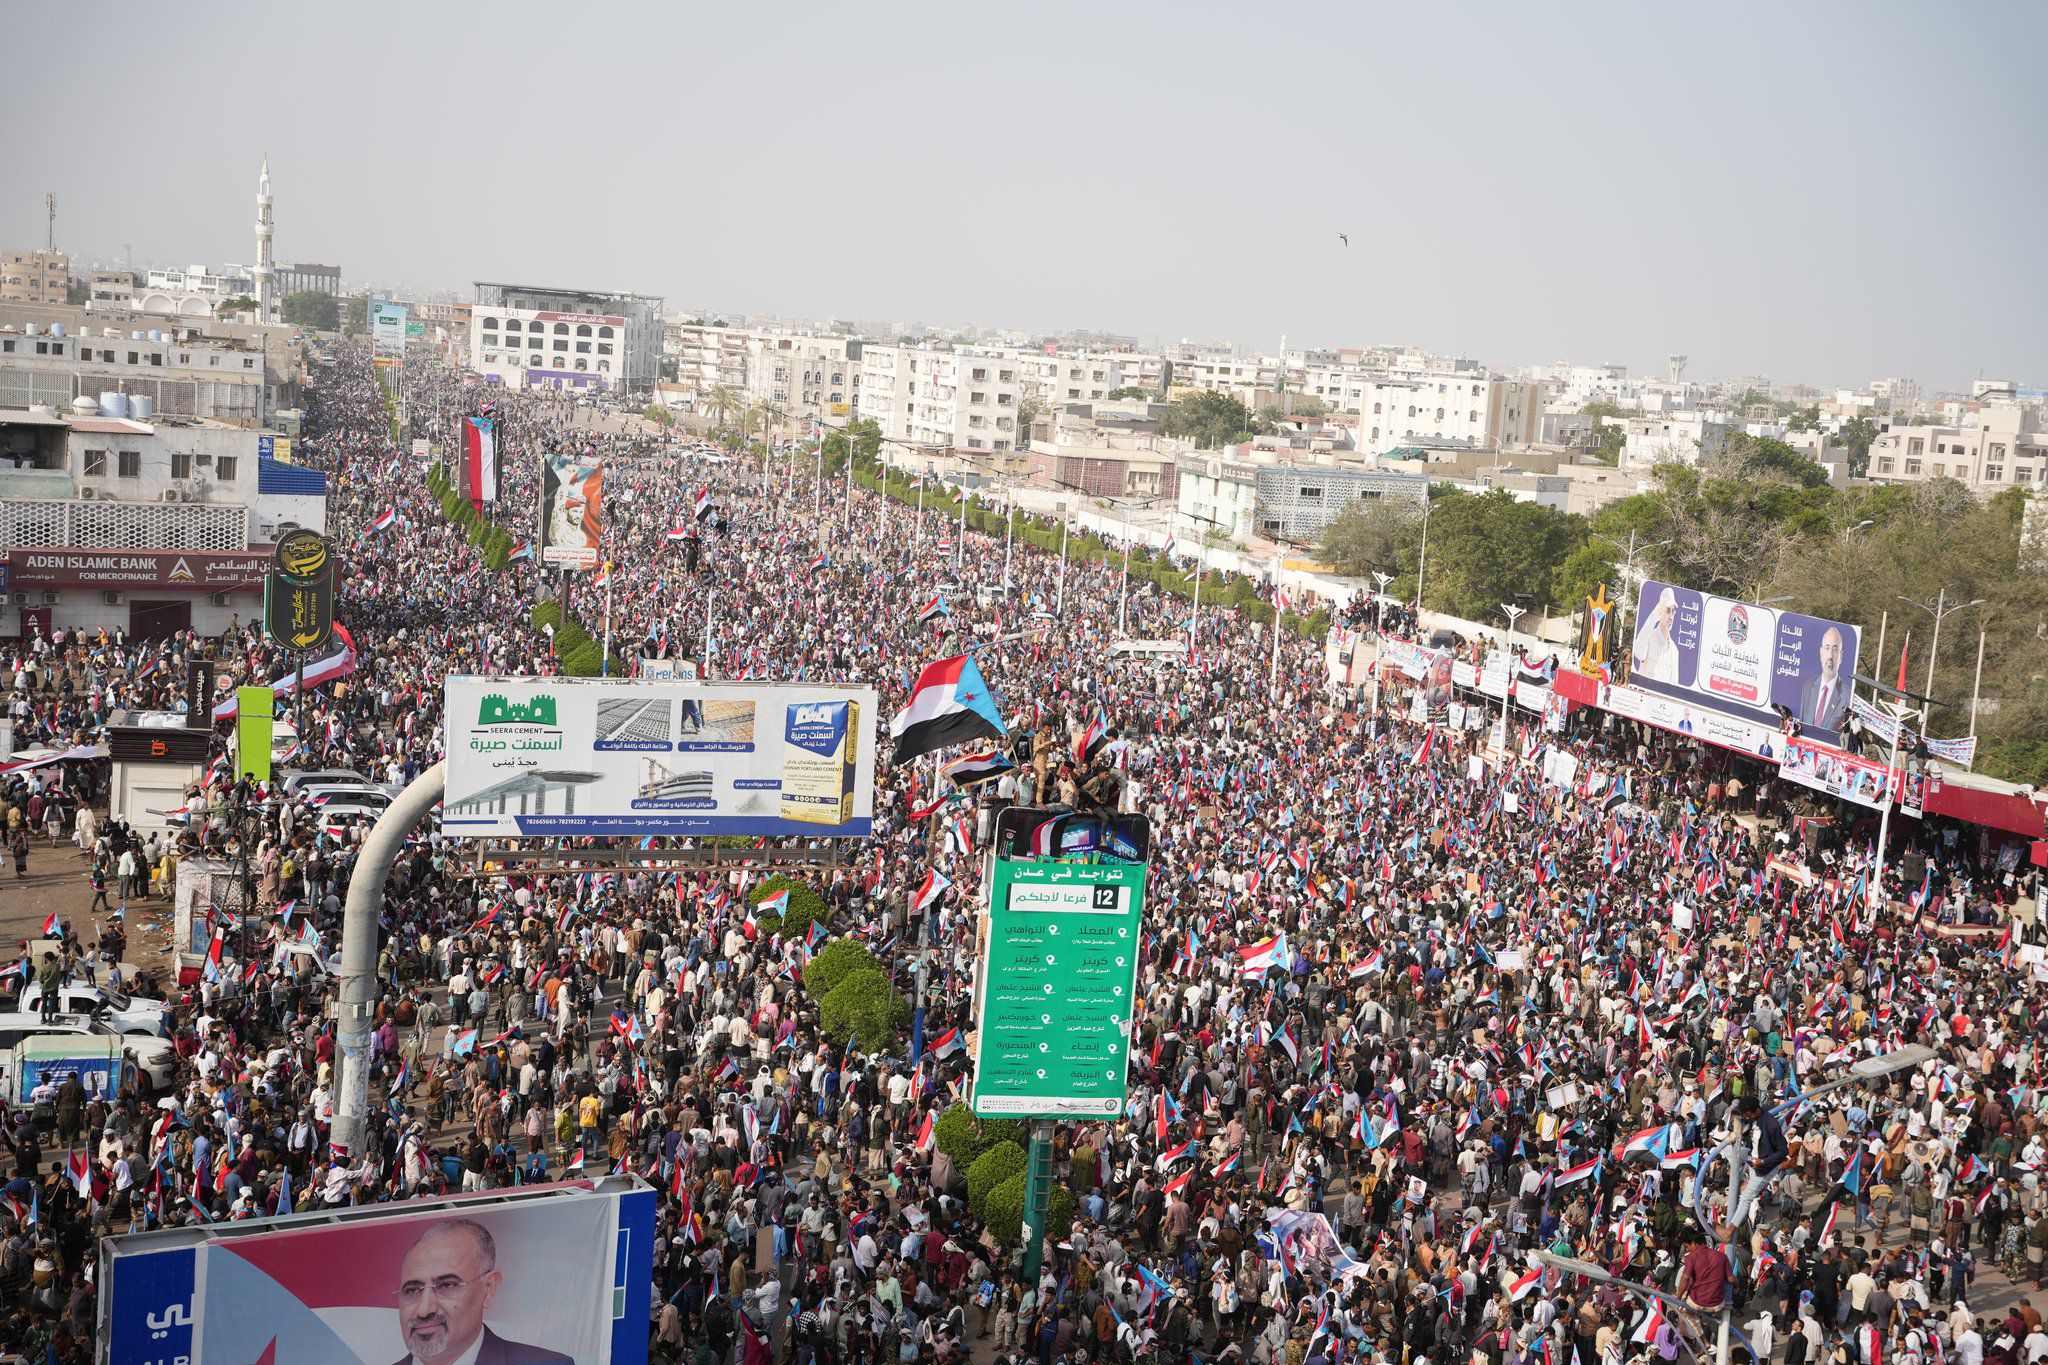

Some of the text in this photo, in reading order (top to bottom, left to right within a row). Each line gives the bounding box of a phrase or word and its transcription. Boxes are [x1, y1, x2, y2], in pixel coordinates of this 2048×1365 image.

[26, 555, 157, 570] ADEN ISLAMIC BANK
[205, 559, 258, 574] الإسلامي
[79, 572, 96, 580] FOR
[97, 572, 157, 581] MICROFINANCE
[1781, 623, 1803, 637] قائدنا
[1779, 637, 1801, 651] الرمز
[1712, 643, 1759, 666] مليونية الثبات
[1776, 663, 1800, 678] المفوض
[790, 730, 834, 741] أسمنت صيرة
[470, 735, 563, 753] أسمنت صيرة
[1014, 867, 1045, 879] عدن
[1051, 867, 1073, 882] في
[1063, 893, 1087, 904] فرعا
[1095, 889, 1114, 906] 12
[1004, 925, 1045, 936] التواهي
